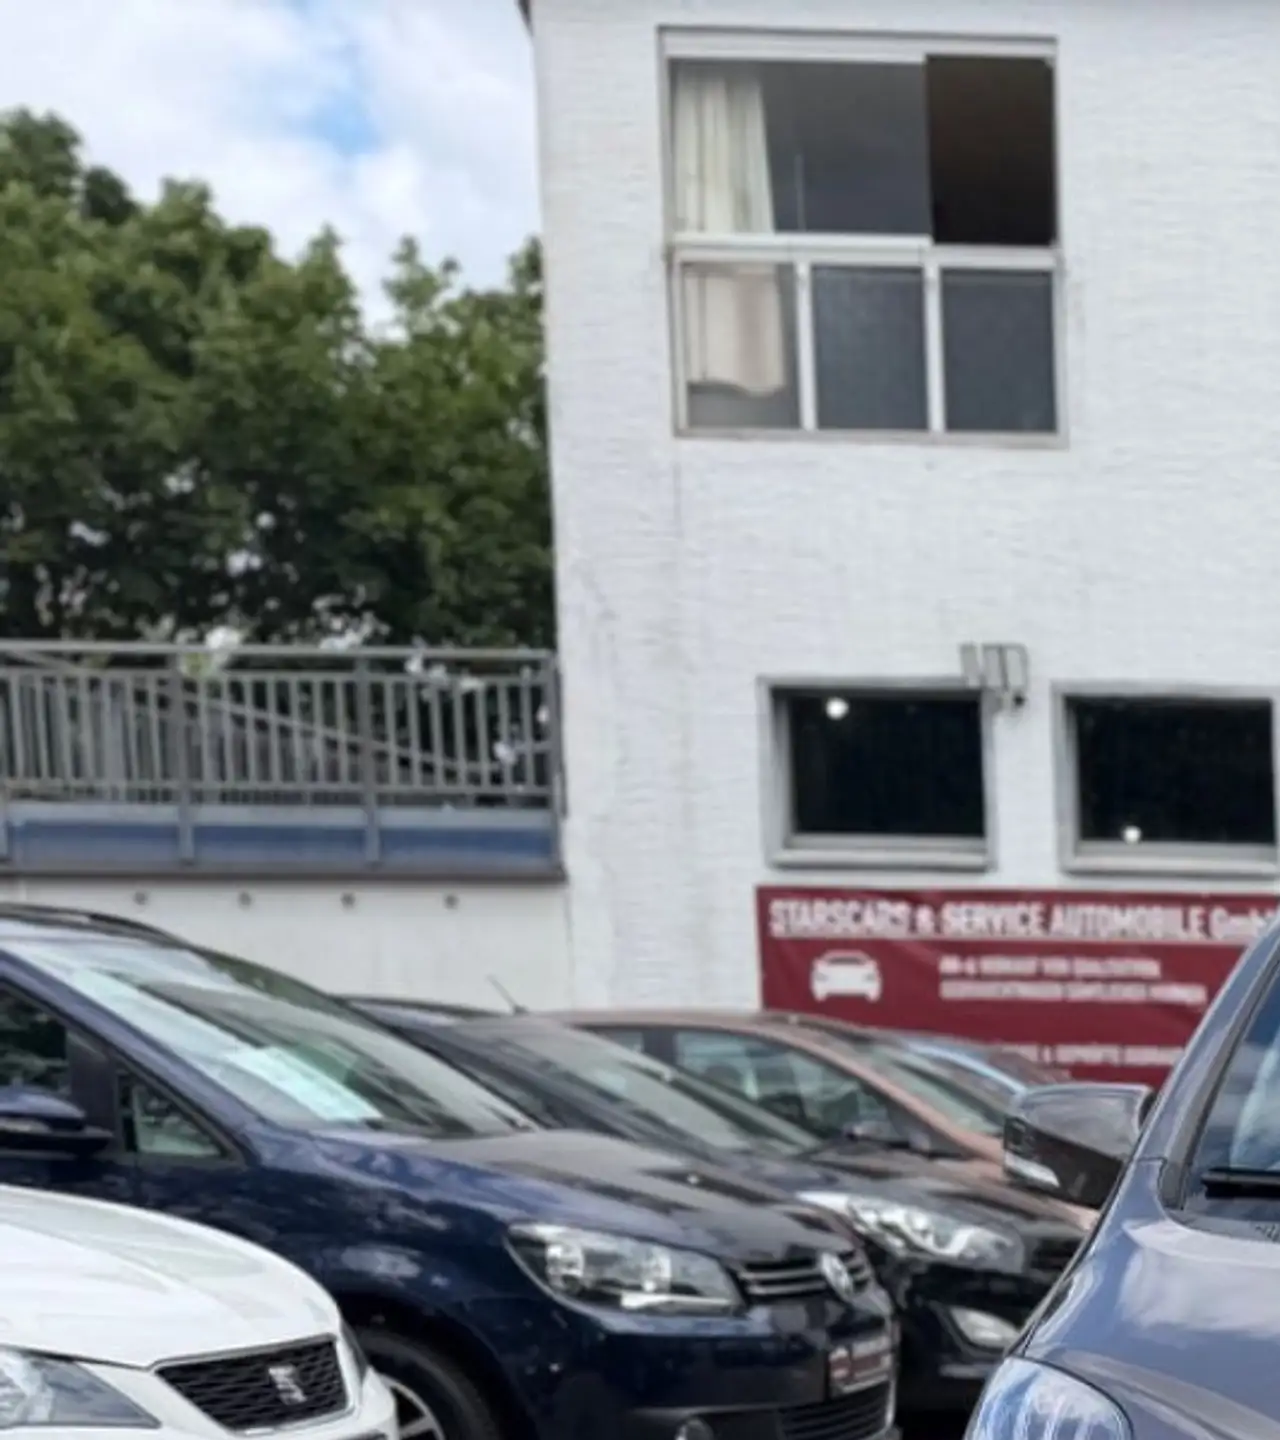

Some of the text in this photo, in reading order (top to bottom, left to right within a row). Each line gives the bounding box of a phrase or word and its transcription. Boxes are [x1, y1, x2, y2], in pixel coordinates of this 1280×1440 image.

[769, 897, 910, 939] STARSCARS
[941, 902, 1046, 940] SERVICE
[1052, 904, 1204, 941] AUTOMOBILE
